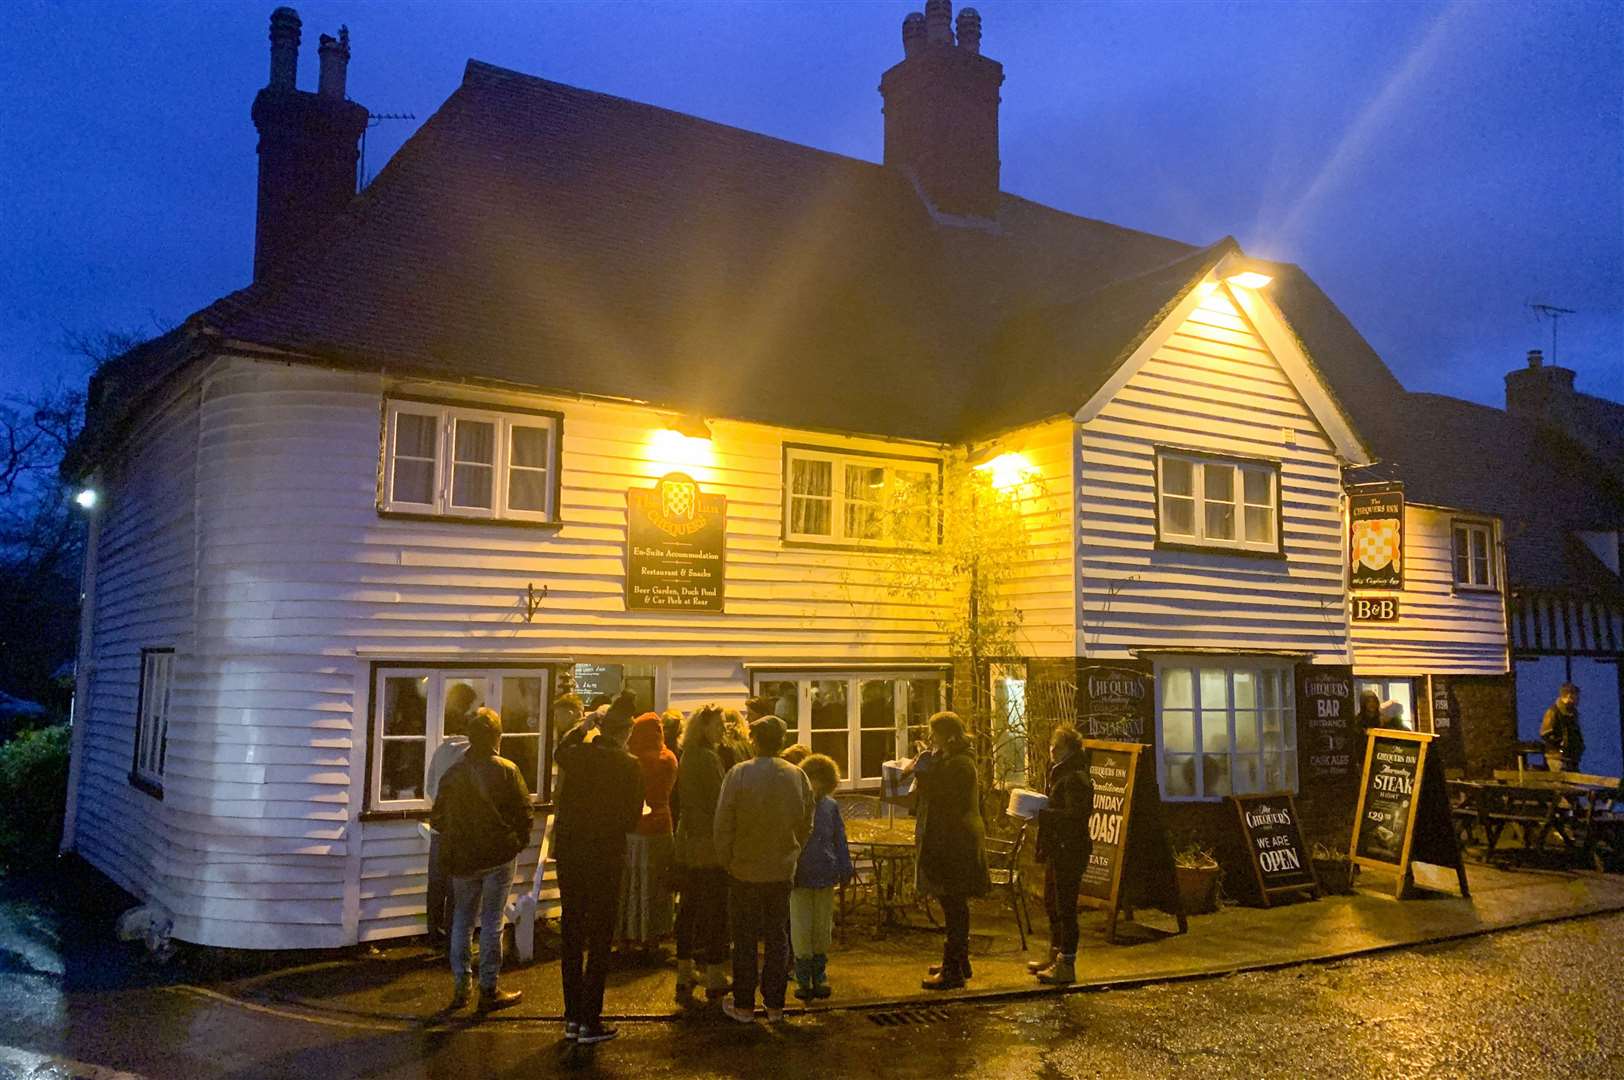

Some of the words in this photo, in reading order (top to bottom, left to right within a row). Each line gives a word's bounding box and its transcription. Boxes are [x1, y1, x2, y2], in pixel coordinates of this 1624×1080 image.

[1353, 504, 1385, 516] CHEQUERS
[1386, 504, 1399, 512] INN
[633, 546, 664, 557] En-Suite
[666, 549, 719, 560] Accommodation
[641, 567, 678, 576] Restaurant
[680, 568, 687, 577] &
[688, 568, 712, 577] Snacks
[634, 585, 650, 593] Beer
[652, 585, 680, 596] Garden,
[681, 587, 700, 596] Duck
[701, 587, 717, 596] Pond
[644, 595, 650, 604] &
[652, 595, 666, 604] Car
[667, 596, 682, 605] Park
[693, 597, 709, 606] Rear
[1356, 600, 1394, 619] B&B
[1088, 674, 1145, 700] CHEQUERS
[1305, 680, 1349, 698] CHEQUERS
[1317, 699, 1340, 717] BAR
[1377, 752, 1405, 763] CHEQUERS
[1090, 766, 1115, 778] CHEQUERS
[1373, 775, 1415, 795] STEAK
[1246, 808, 1291, 829] CHEQUERS
[1257, 837, 1271, 849] WE
[1272, 835, 1291, 847] ARE
[1260, 847, 1300, 872] OPEN
